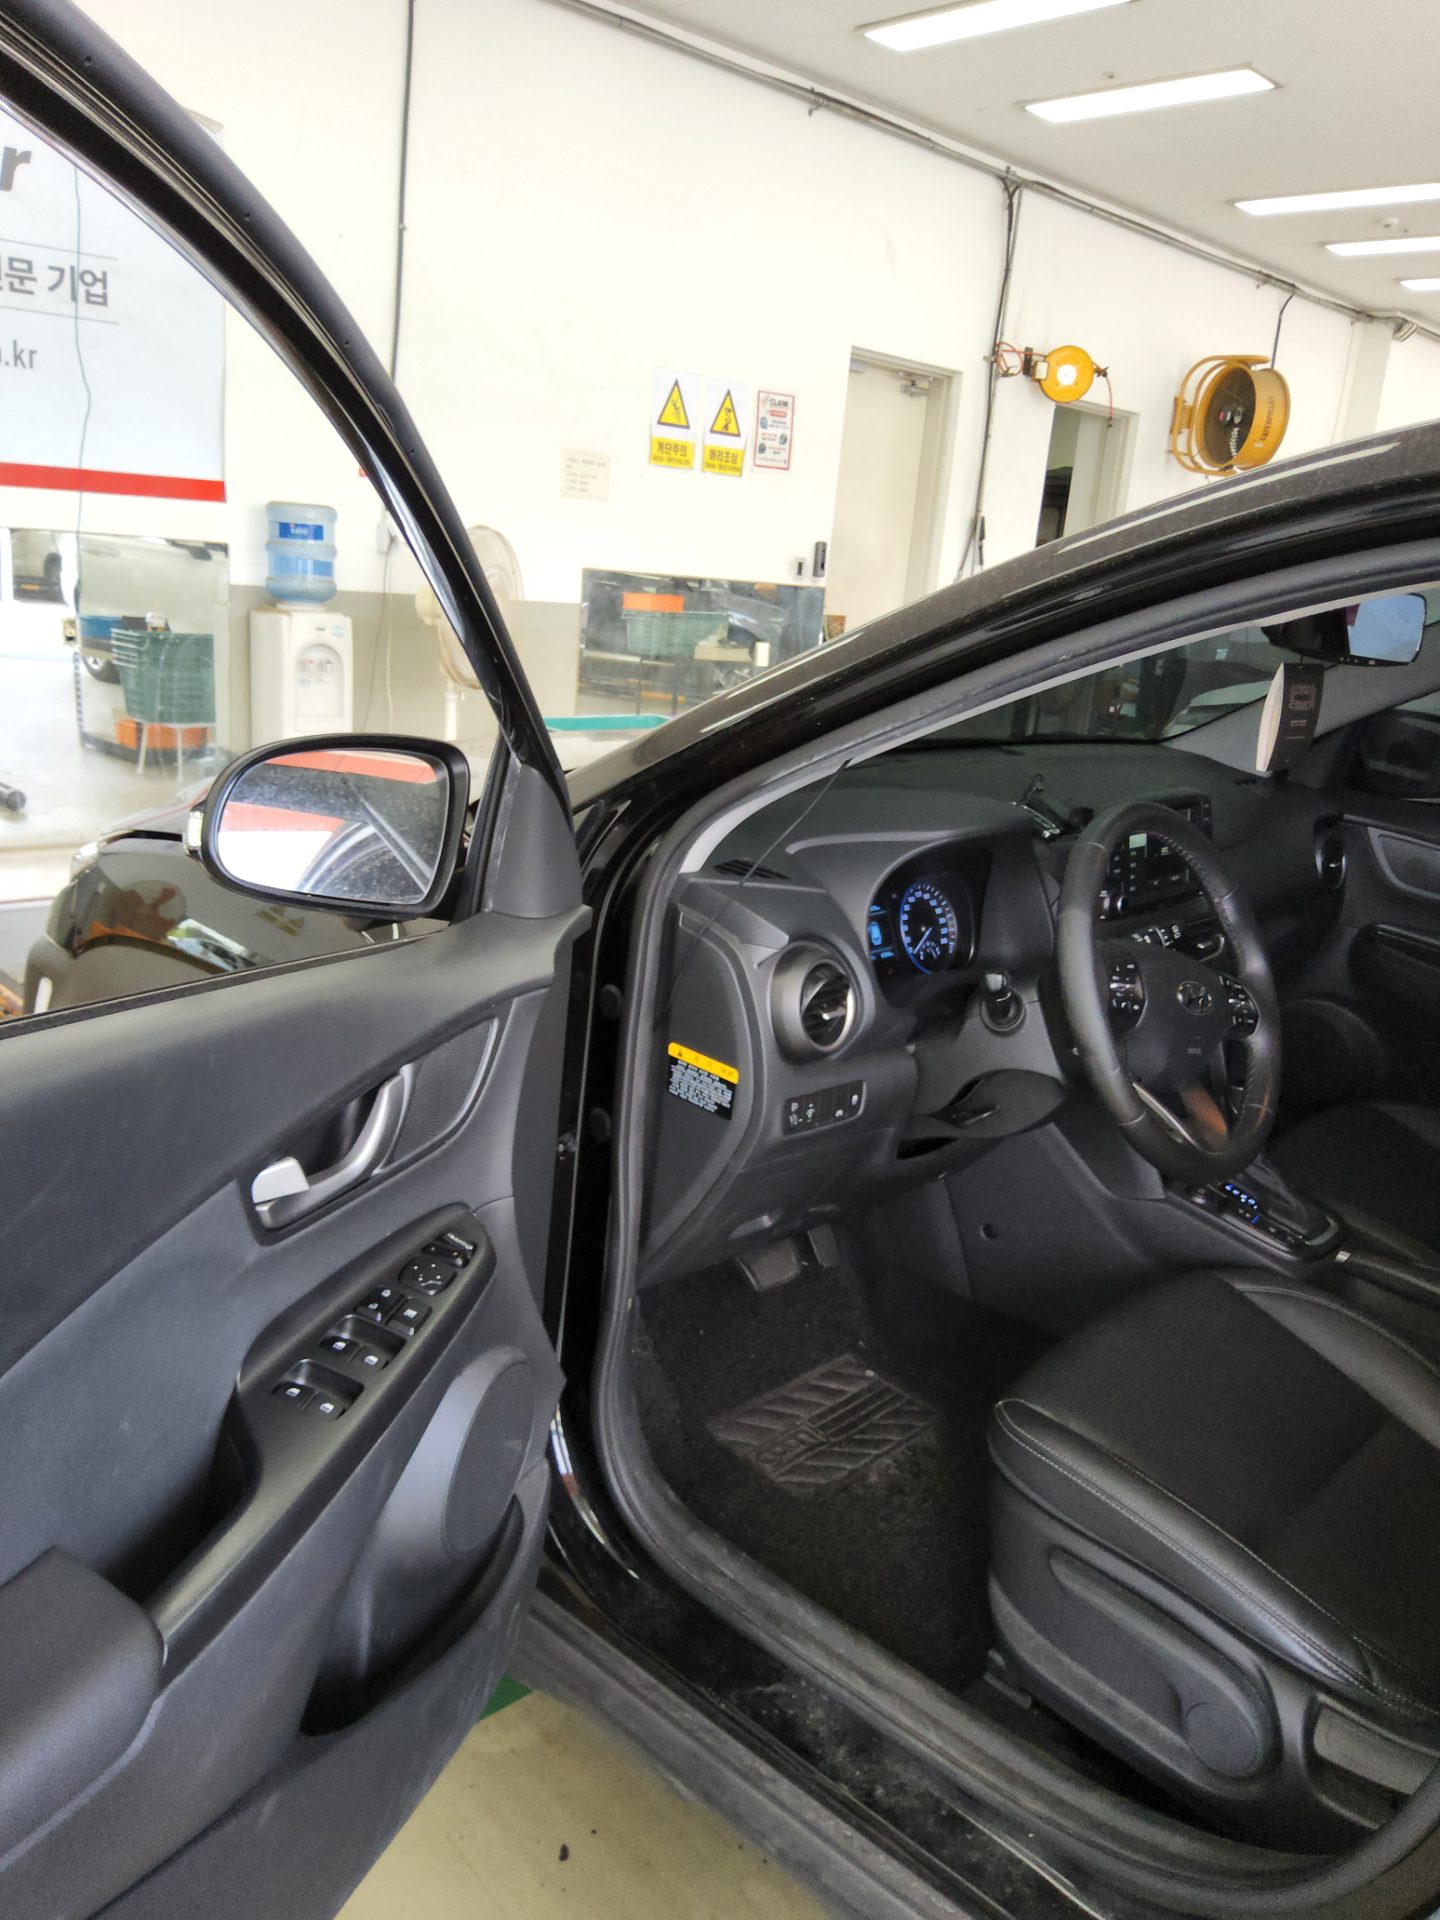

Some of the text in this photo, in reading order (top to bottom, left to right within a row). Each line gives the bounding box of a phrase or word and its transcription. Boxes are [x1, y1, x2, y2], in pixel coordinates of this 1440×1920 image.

[0, 254, 109, 307] 문 기업
[0, 339, 37, 369] .kr
